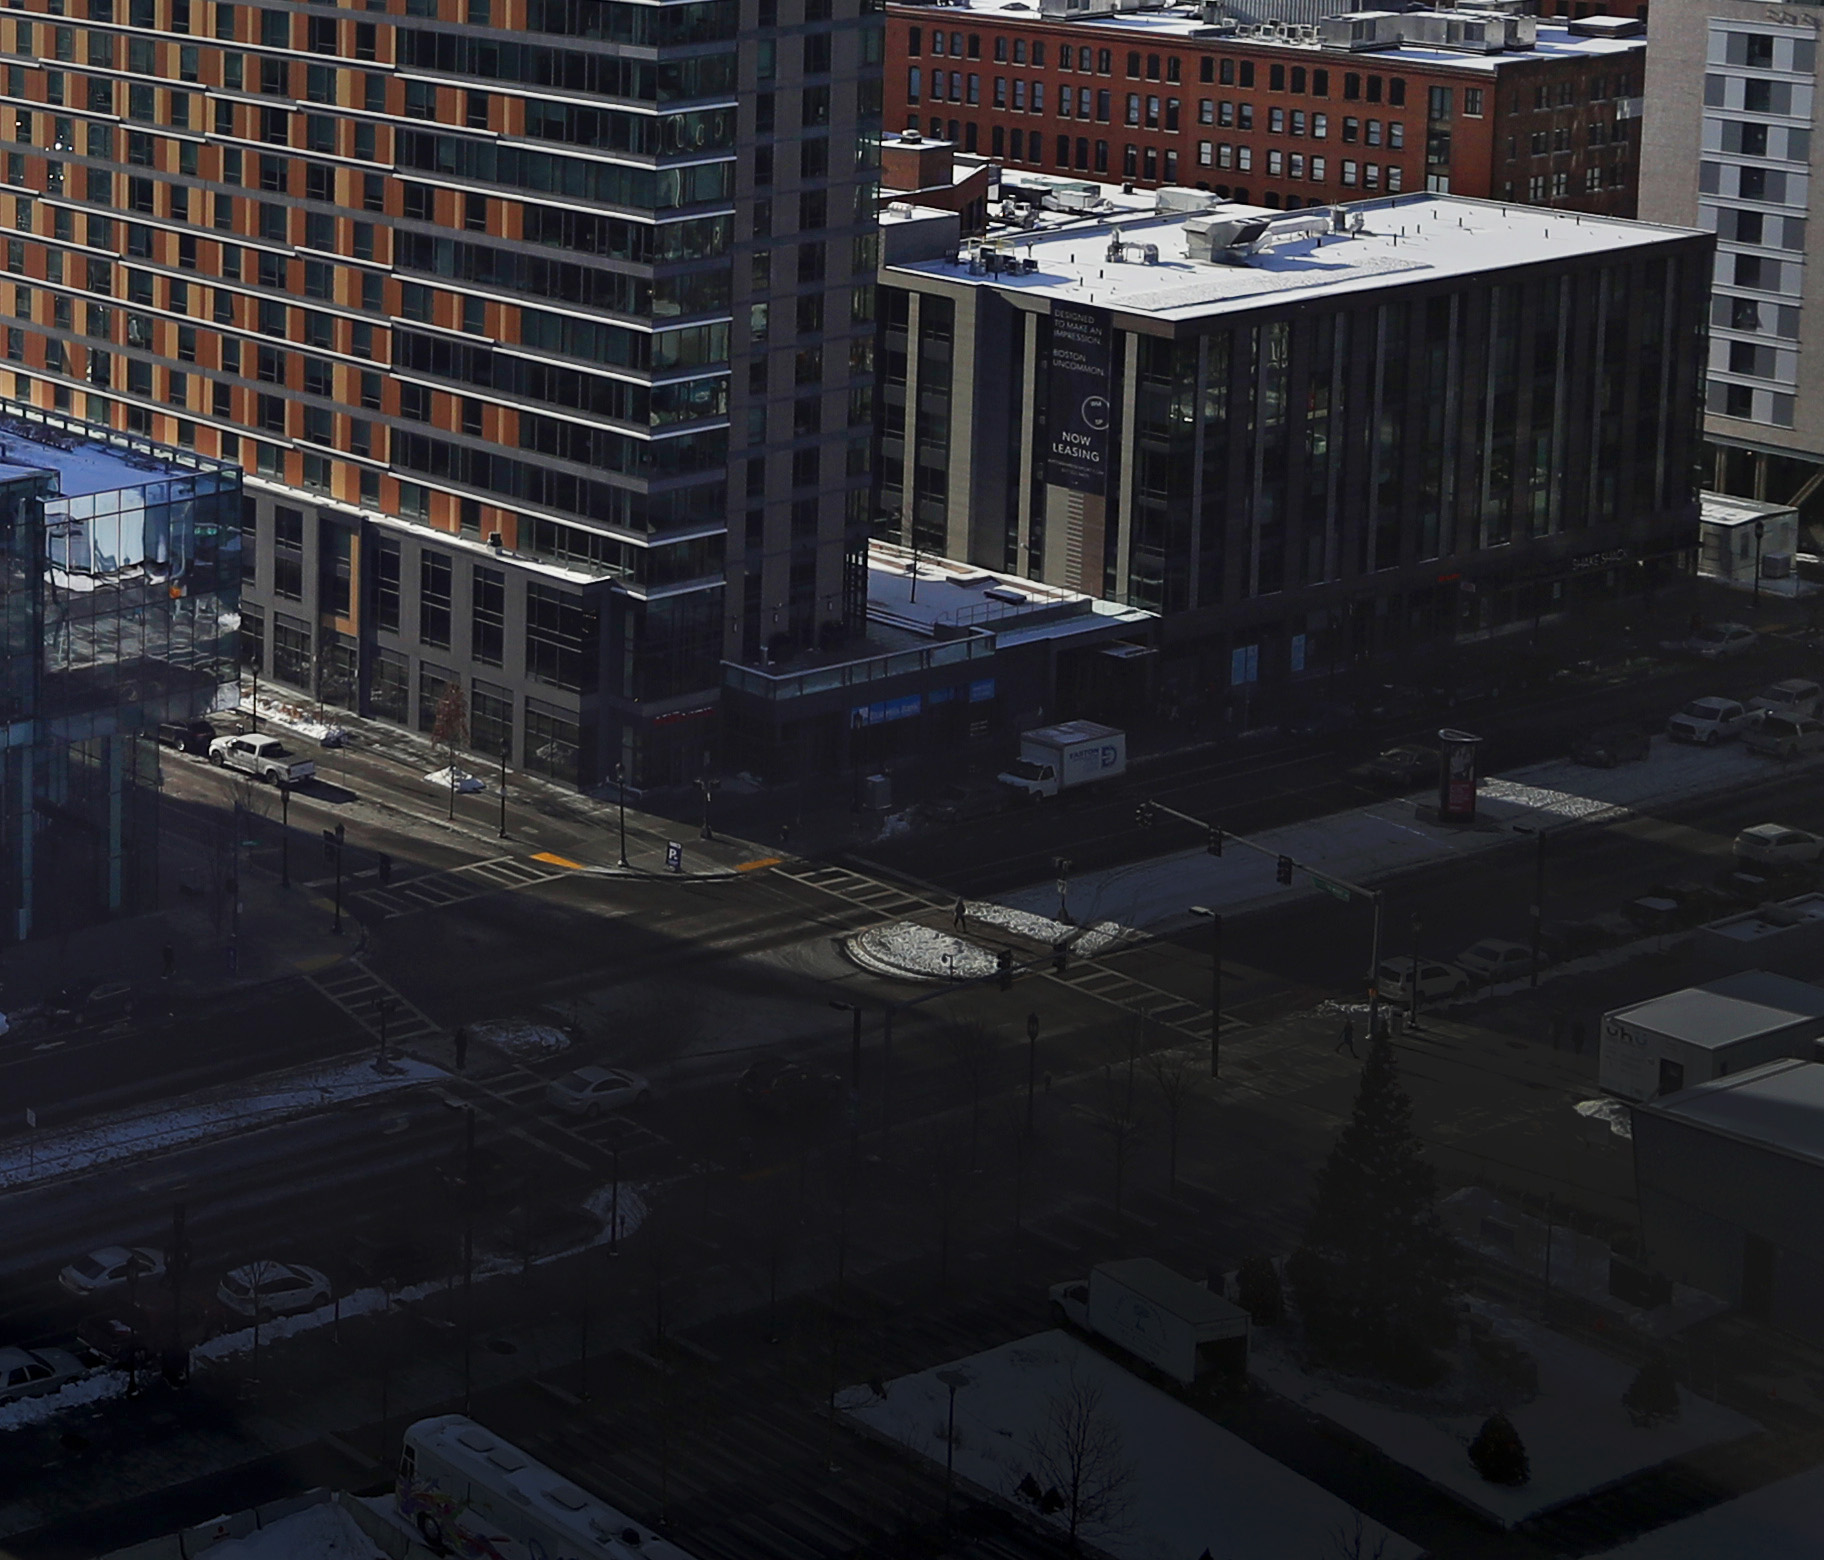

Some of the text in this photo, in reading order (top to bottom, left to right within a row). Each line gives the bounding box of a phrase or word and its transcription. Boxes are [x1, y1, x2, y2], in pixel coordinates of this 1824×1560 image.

[1055, 309, 1095, 324] DESIGNED
[1055, 319, 1066, 328] TO
[1090, 326, 1102, 336] AN
[1062, 431, 1091, 446] NOW
[1052, 442, 1100, 462] LEASING
